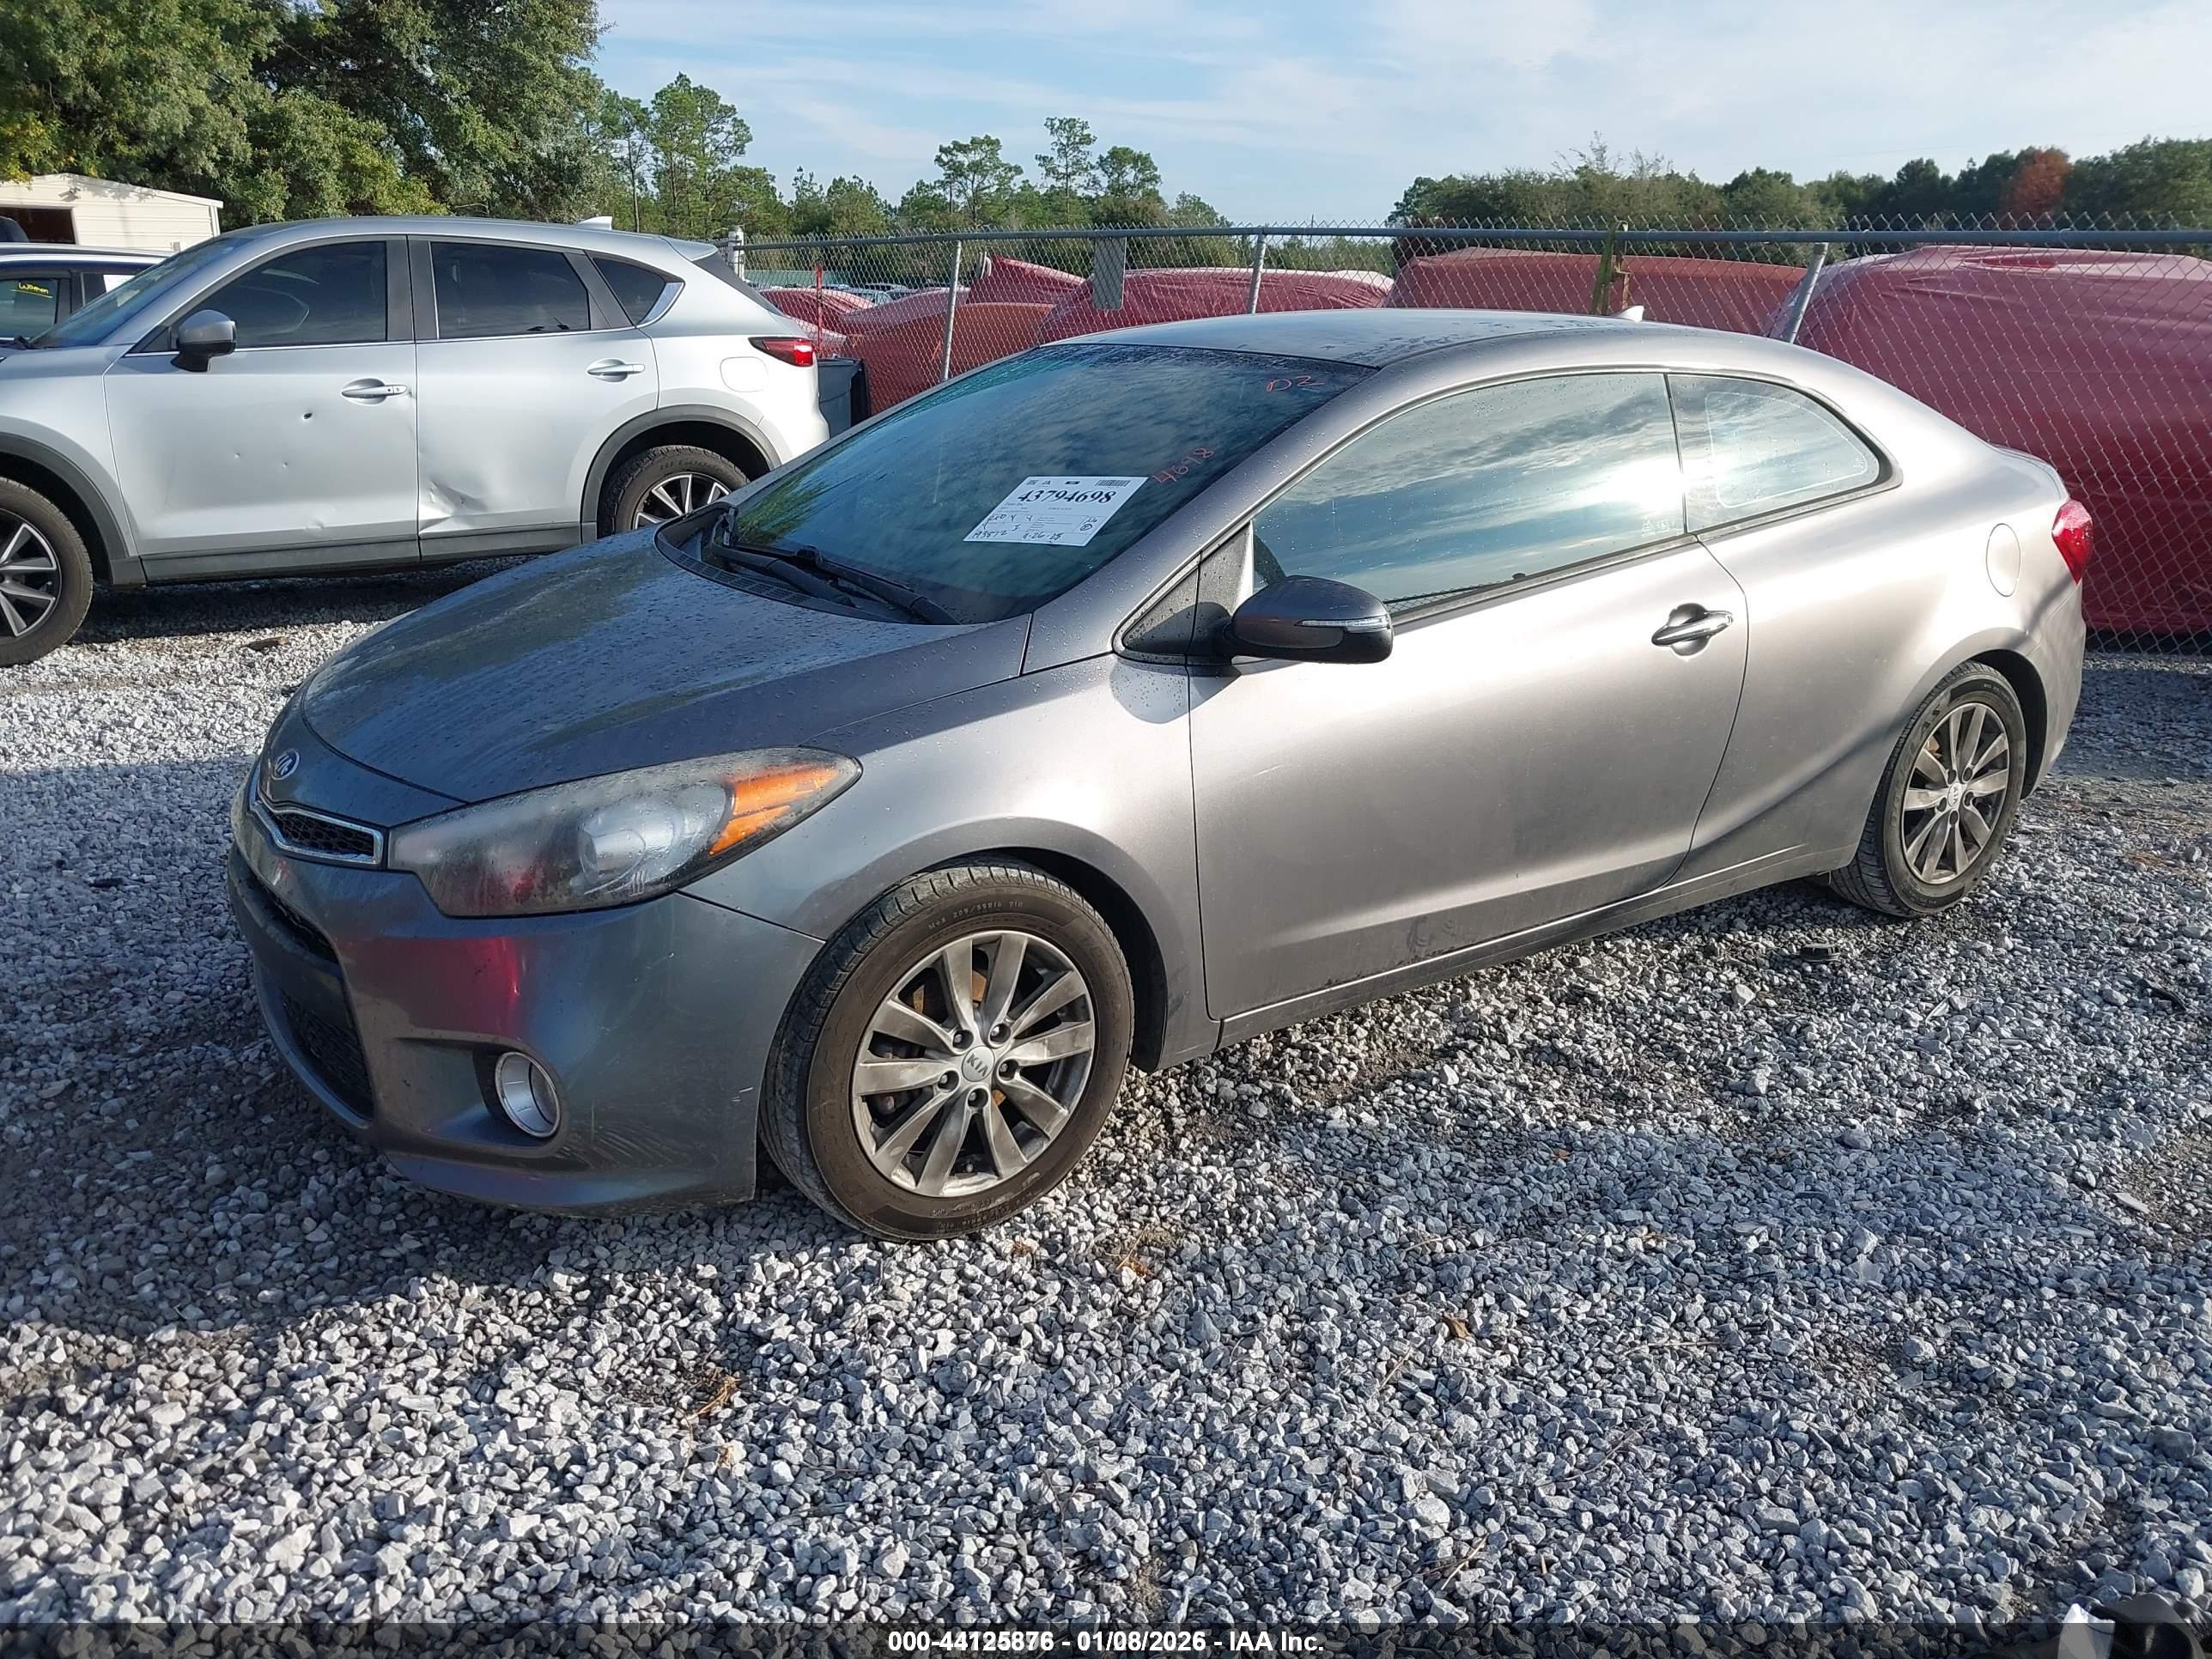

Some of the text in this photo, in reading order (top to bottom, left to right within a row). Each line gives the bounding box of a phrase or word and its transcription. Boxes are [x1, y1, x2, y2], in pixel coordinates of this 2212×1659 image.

[1151, 447, 1215, 484] 4698
[1017, 489, 1117, 503] 43794698
[966, 1053, 989, 1078] KIA
